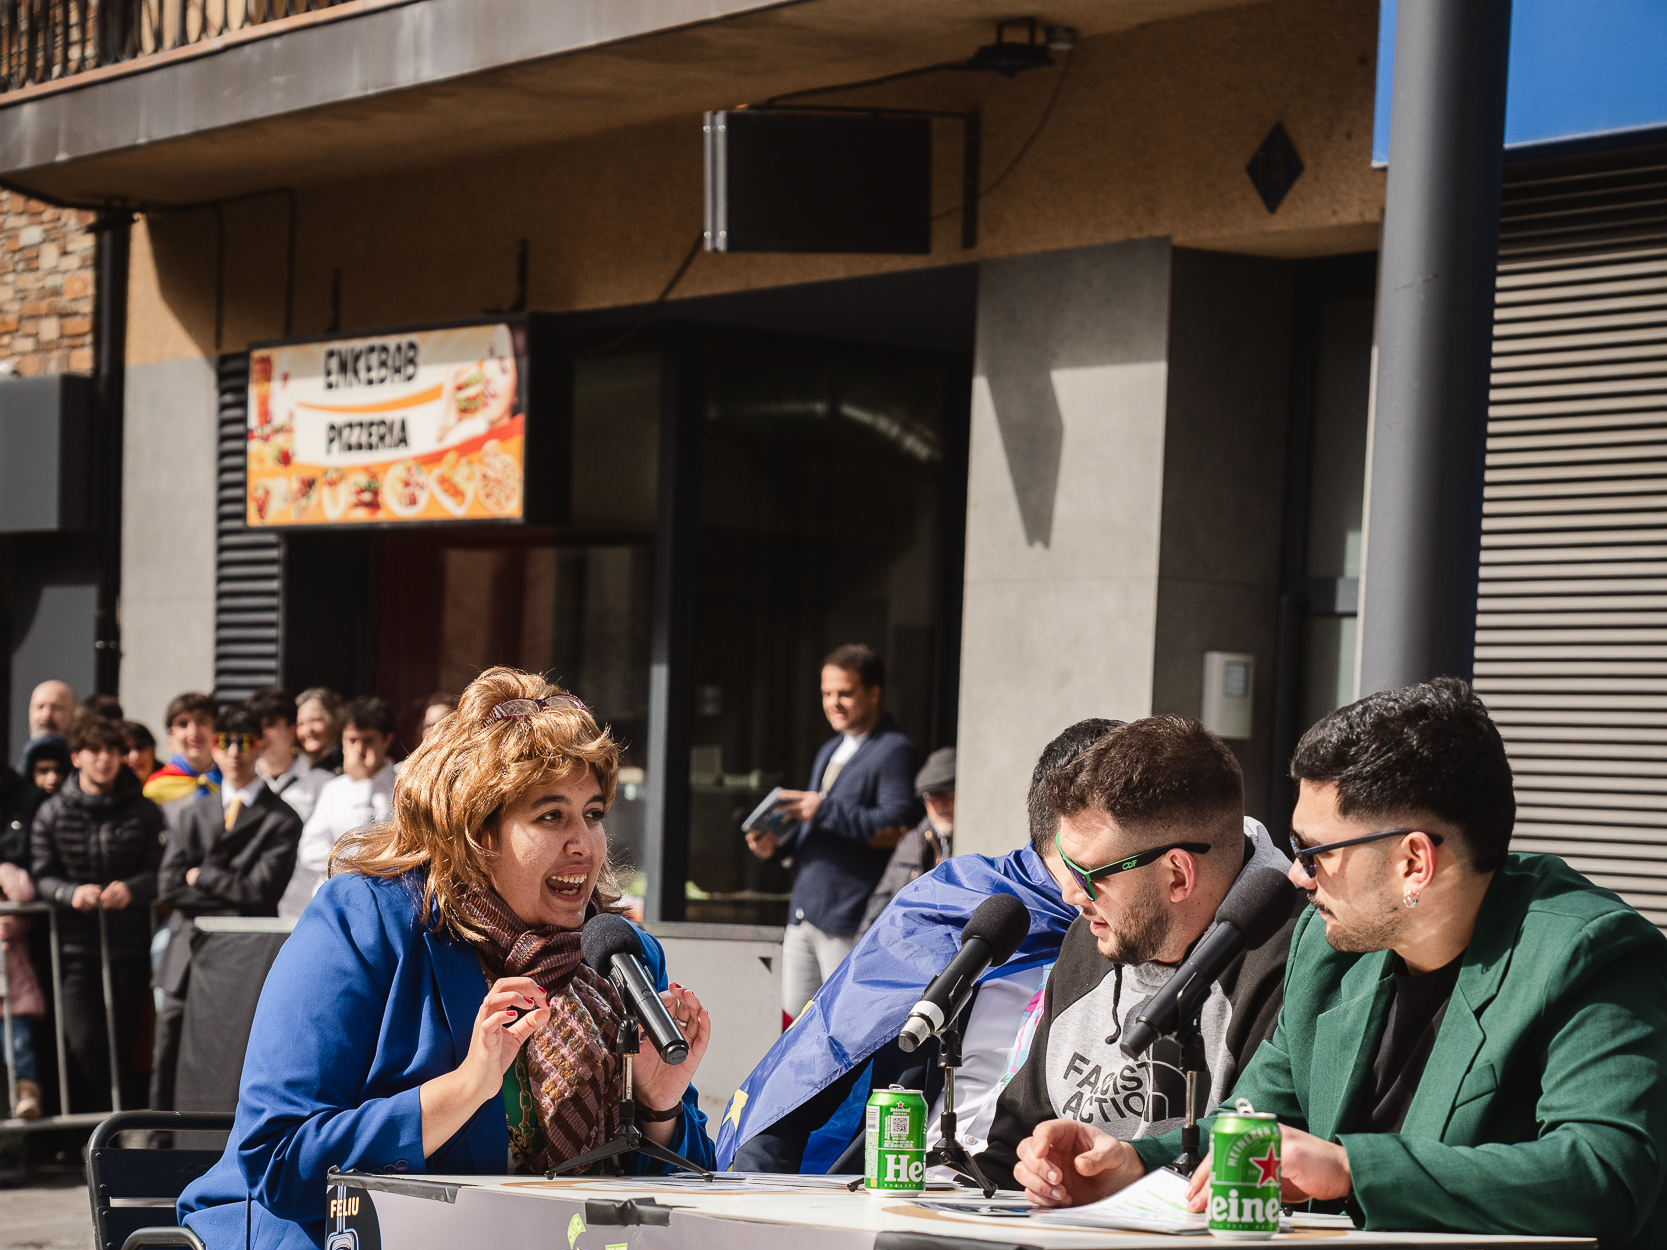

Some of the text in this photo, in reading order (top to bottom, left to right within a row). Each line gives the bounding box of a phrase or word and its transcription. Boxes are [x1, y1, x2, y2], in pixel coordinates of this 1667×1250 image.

[324, 341, 419, 389] ENKEBAB
[326, 417, 409, 454] PIZZERIA
[330, 1197, 360, 1219] FELIU
